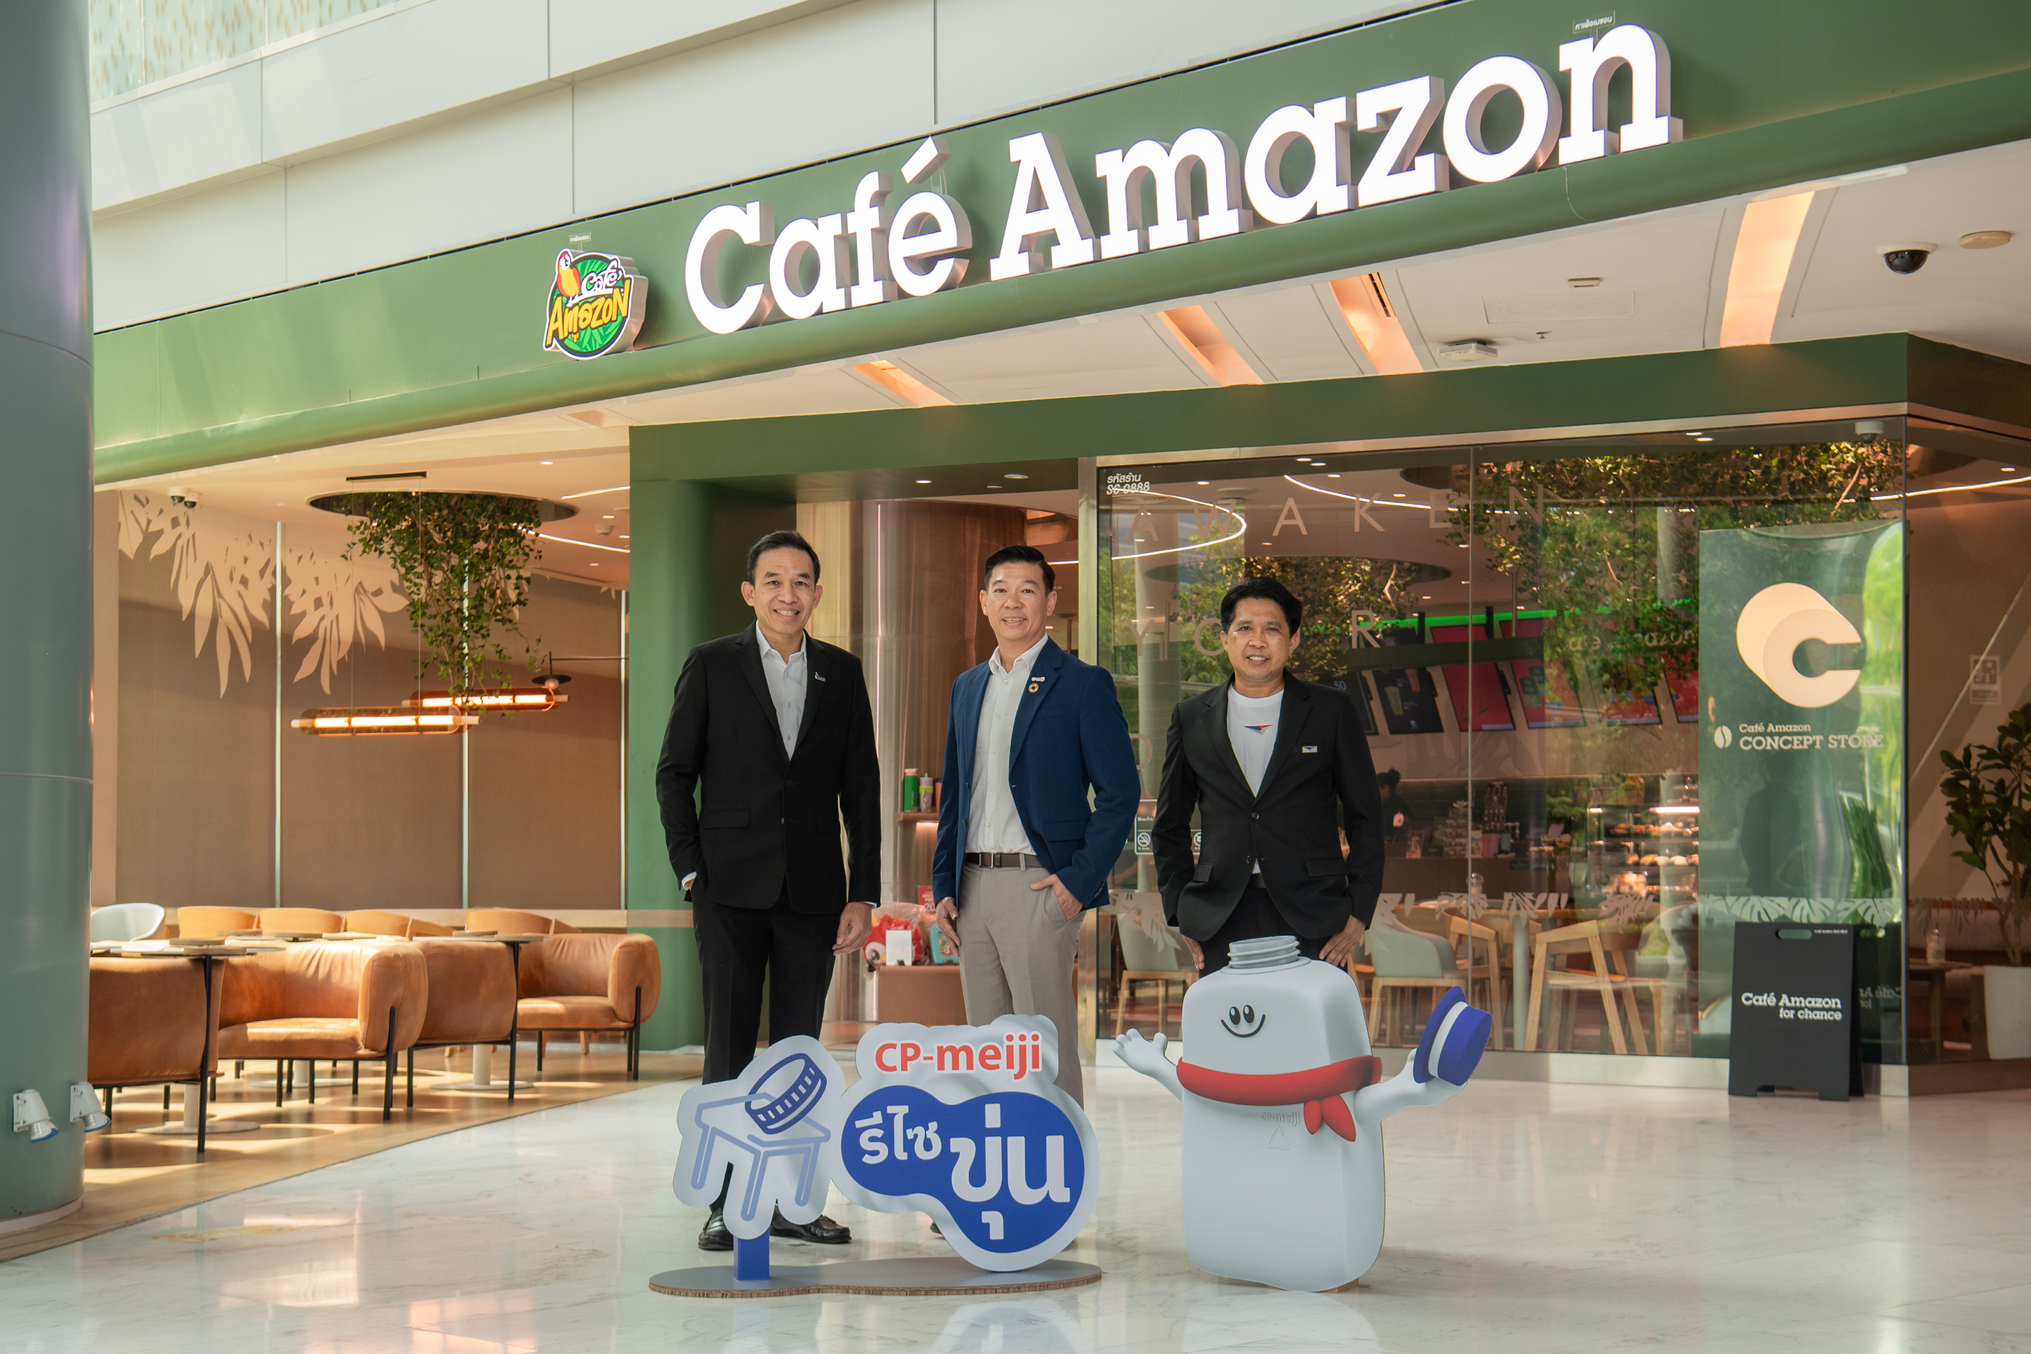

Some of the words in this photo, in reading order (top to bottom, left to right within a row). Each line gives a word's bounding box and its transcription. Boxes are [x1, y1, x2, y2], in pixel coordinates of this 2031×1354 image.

[685, 136, 970, 334] Café
[990, 23, 1678, 281] Amazon
[1106, 472, 1142, 484] รหัสร้าน
[1122, 480, 1151, 495] 0888
[1126, 484, 1544, 543] AWAKEN
[1739, 722, 1765, 733] Café
[1766, 723, 1812, 734] Amazon
[1739, 735, 1824, 750] CONCEPT
[1828, 734, 1884, 749] STORE
[1741, 992, 1777, 1007] Café
[1778, 993, 1842, 1009] Amazon
[1779, 1007, 1795, 1019] for
[1797, 1008, 1842, 1021] chance
[875, 1033, 1041, 1081] CP-meiji
